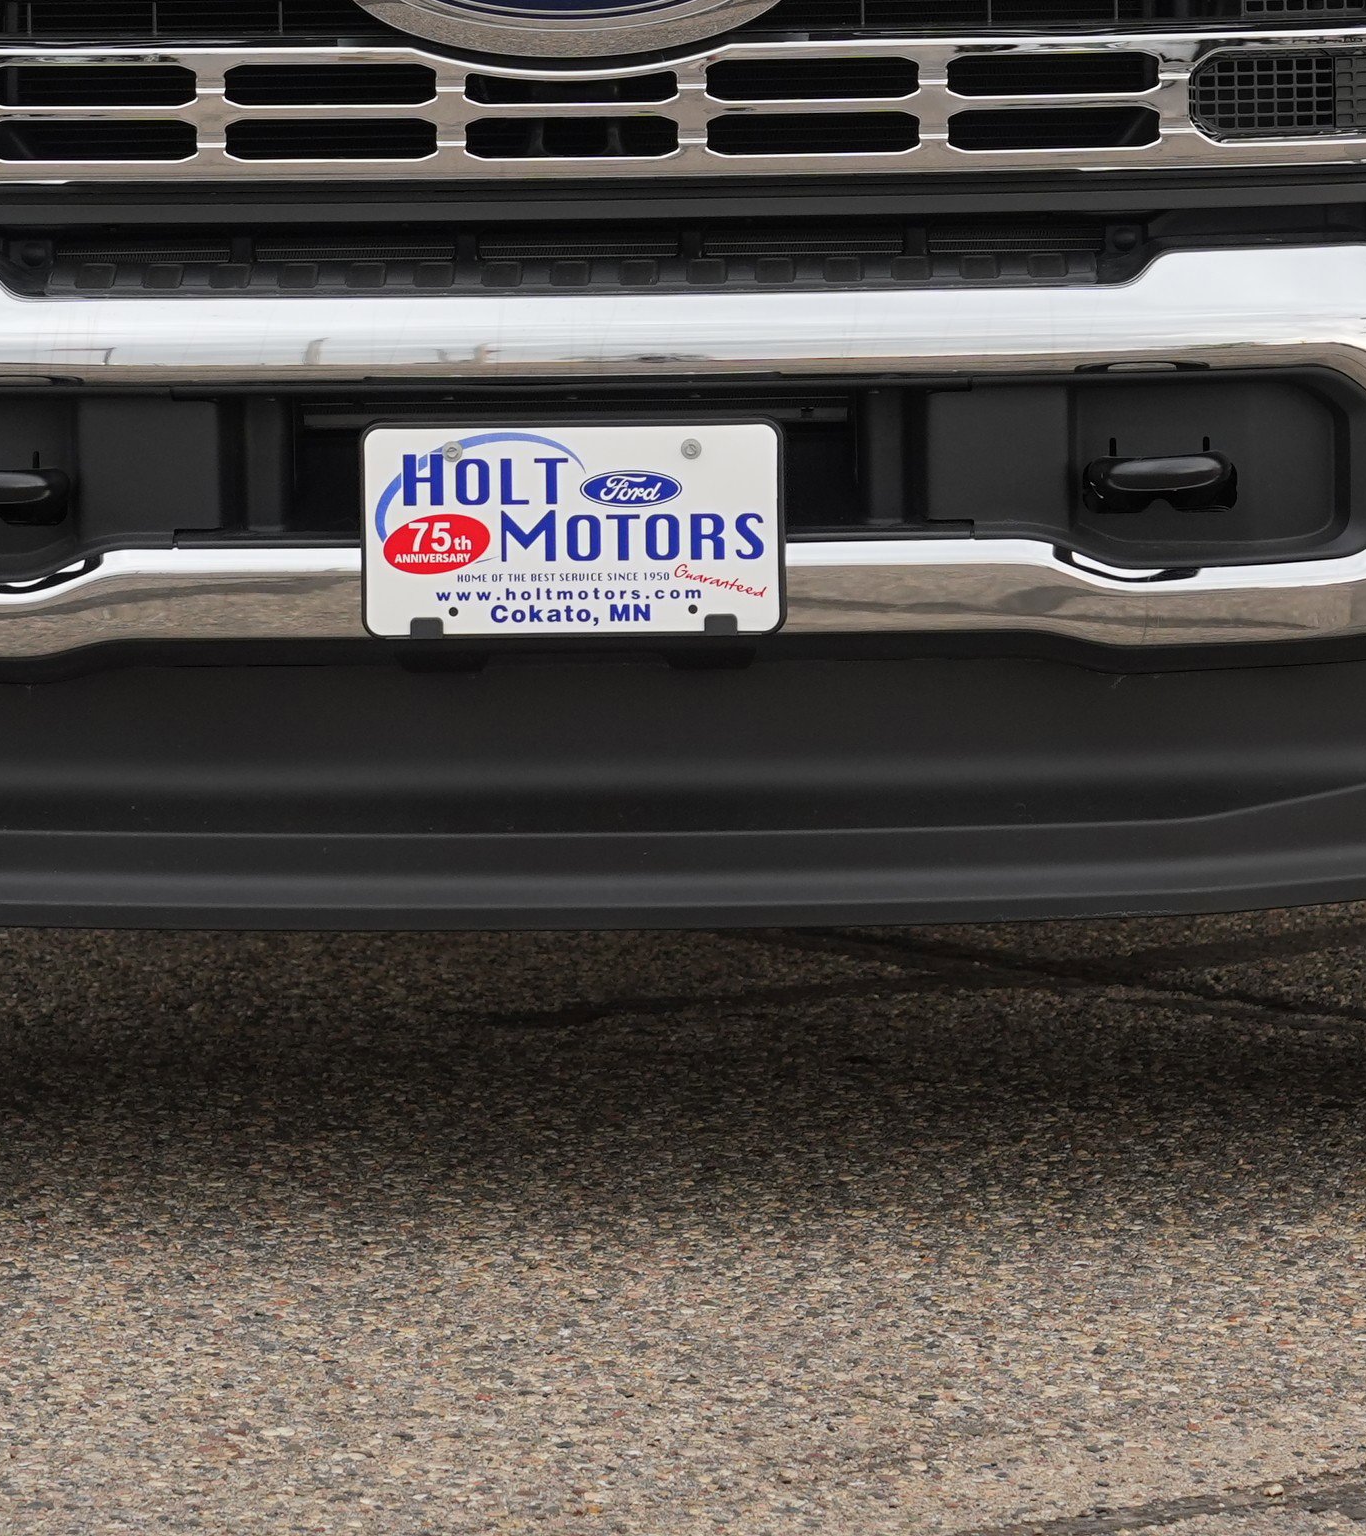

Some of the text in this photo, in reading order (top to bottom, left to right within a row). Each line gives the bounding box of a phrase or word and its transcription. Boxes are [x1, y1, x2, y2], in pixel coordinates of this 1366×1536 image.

[402, 453, 568, 507] HOLT
[600, 475, 661, 502] Ford
[408, 521, 472, 552] 75th
[500, 509, 764, 562] MOTORS
[394, 551, 471, 565] ANNIVERSARY
[457, 571, 670, 583] HOME OF THE BEST SERVICE SINCE 1950
[673, 563, 768, 598] Guaranteed
[436, 586, 702, 602] www.holtmotors.com
[490, 604, 651, 627] Cokato, MN
